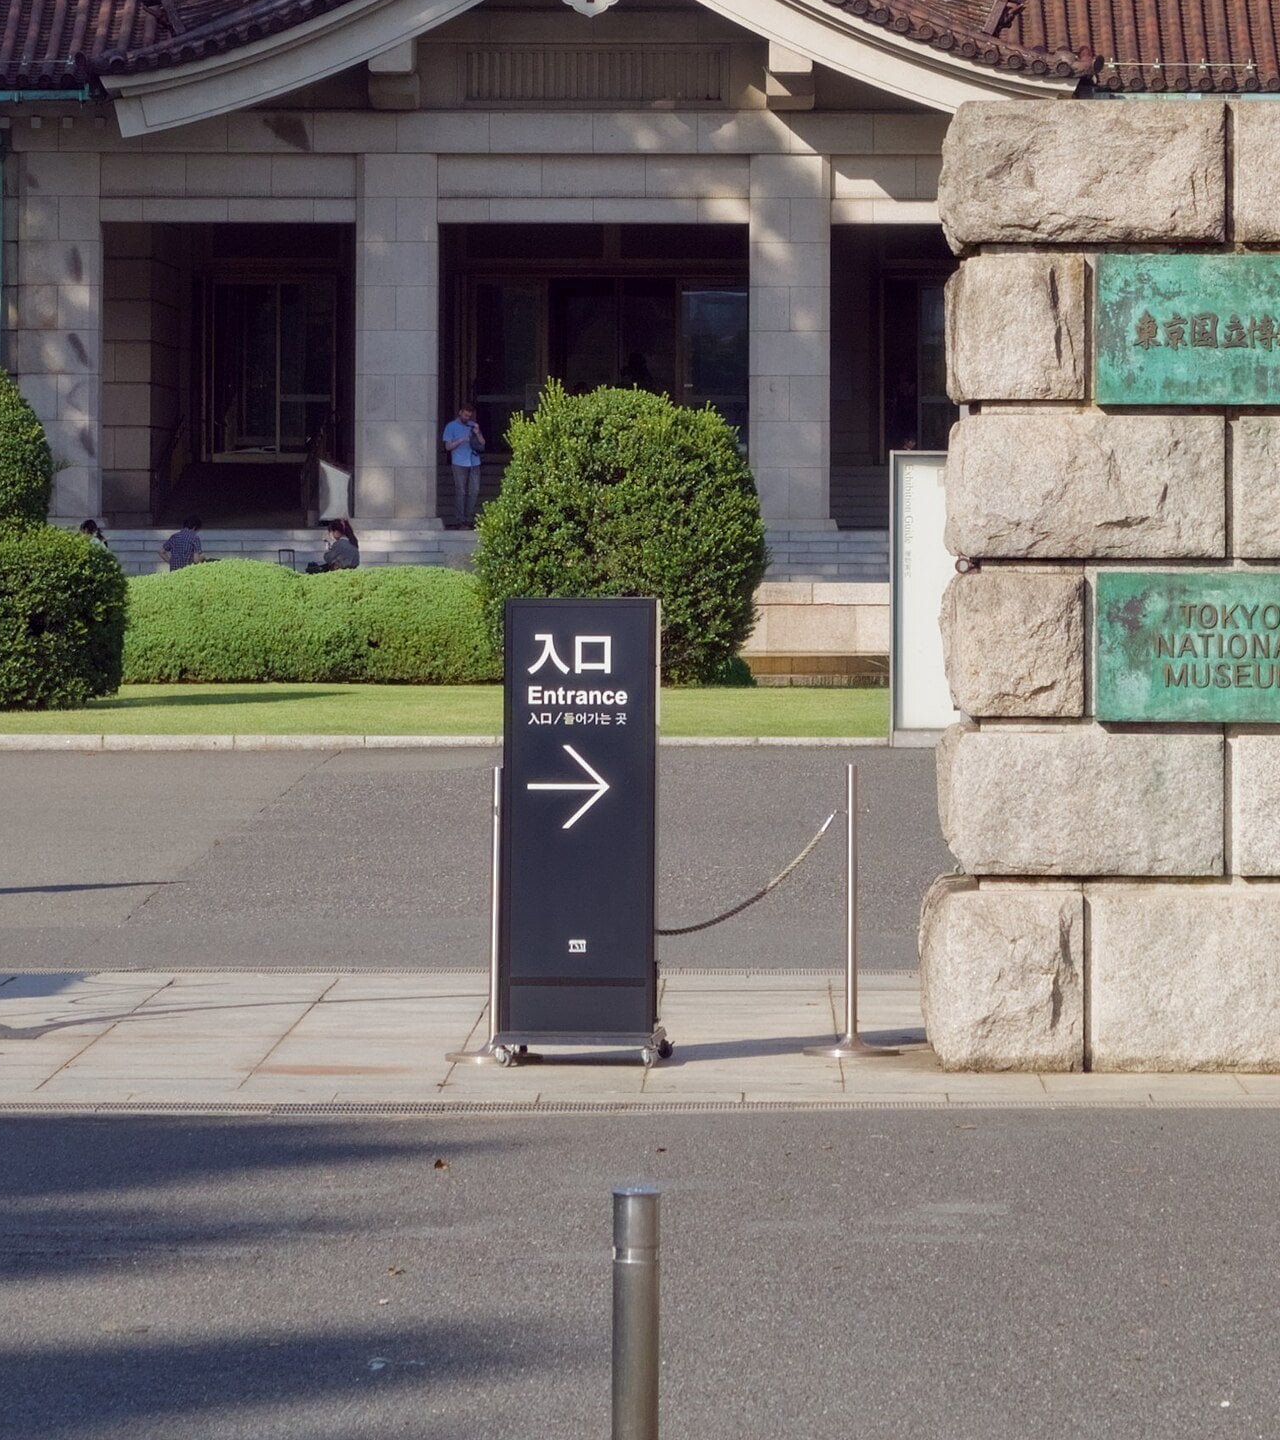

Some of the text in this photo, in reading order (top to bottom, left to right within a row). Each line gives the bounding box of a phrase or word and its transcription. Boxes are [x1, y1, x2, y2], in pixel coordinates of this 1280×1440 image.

[527, 634, 612, 675] 入口
[527, 686, 628, 705] Entrance
[615, 712, 628, 725] 곳
